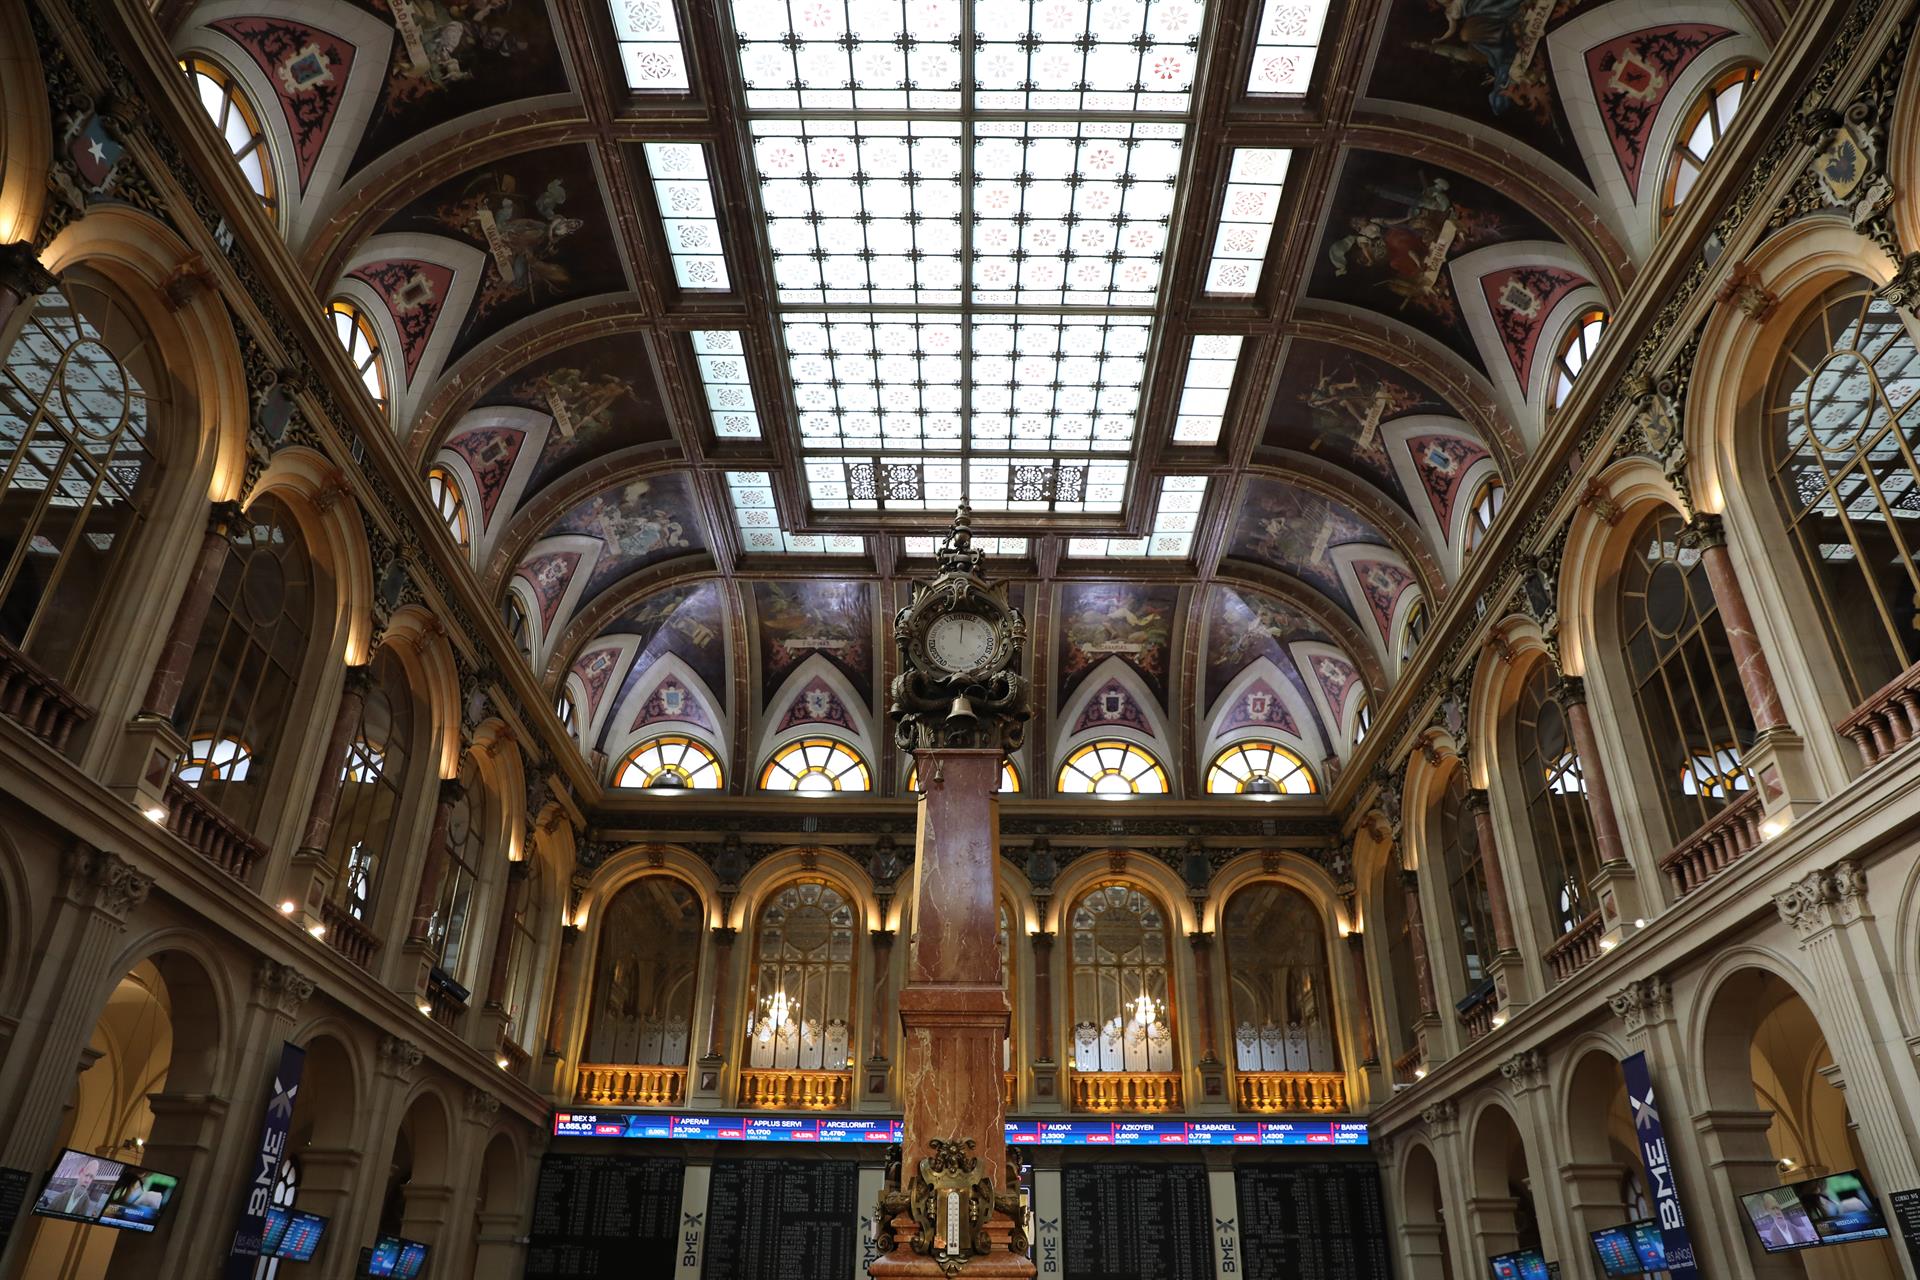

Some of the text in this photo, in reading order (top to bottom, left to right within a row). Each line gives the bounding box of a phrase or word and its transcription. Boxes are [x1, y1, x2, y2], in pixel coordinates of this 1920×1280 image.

[944, 613, 978, 624] VARIABLE
[928, 639, 948, 667] TEMPESTAD
[974, 637, 994, 667] MUY SECO
[826, 1121, 877, 1129] ARCELORMITT.
[247, 1131, 283, 1217] BME
[1644, 1138, 1681, 1231] BME
[683, 1231, 699, 1267] BME
[1043, 1237, 1056, 1273] BME
[1221, 1237, 1235, 1273] BME
